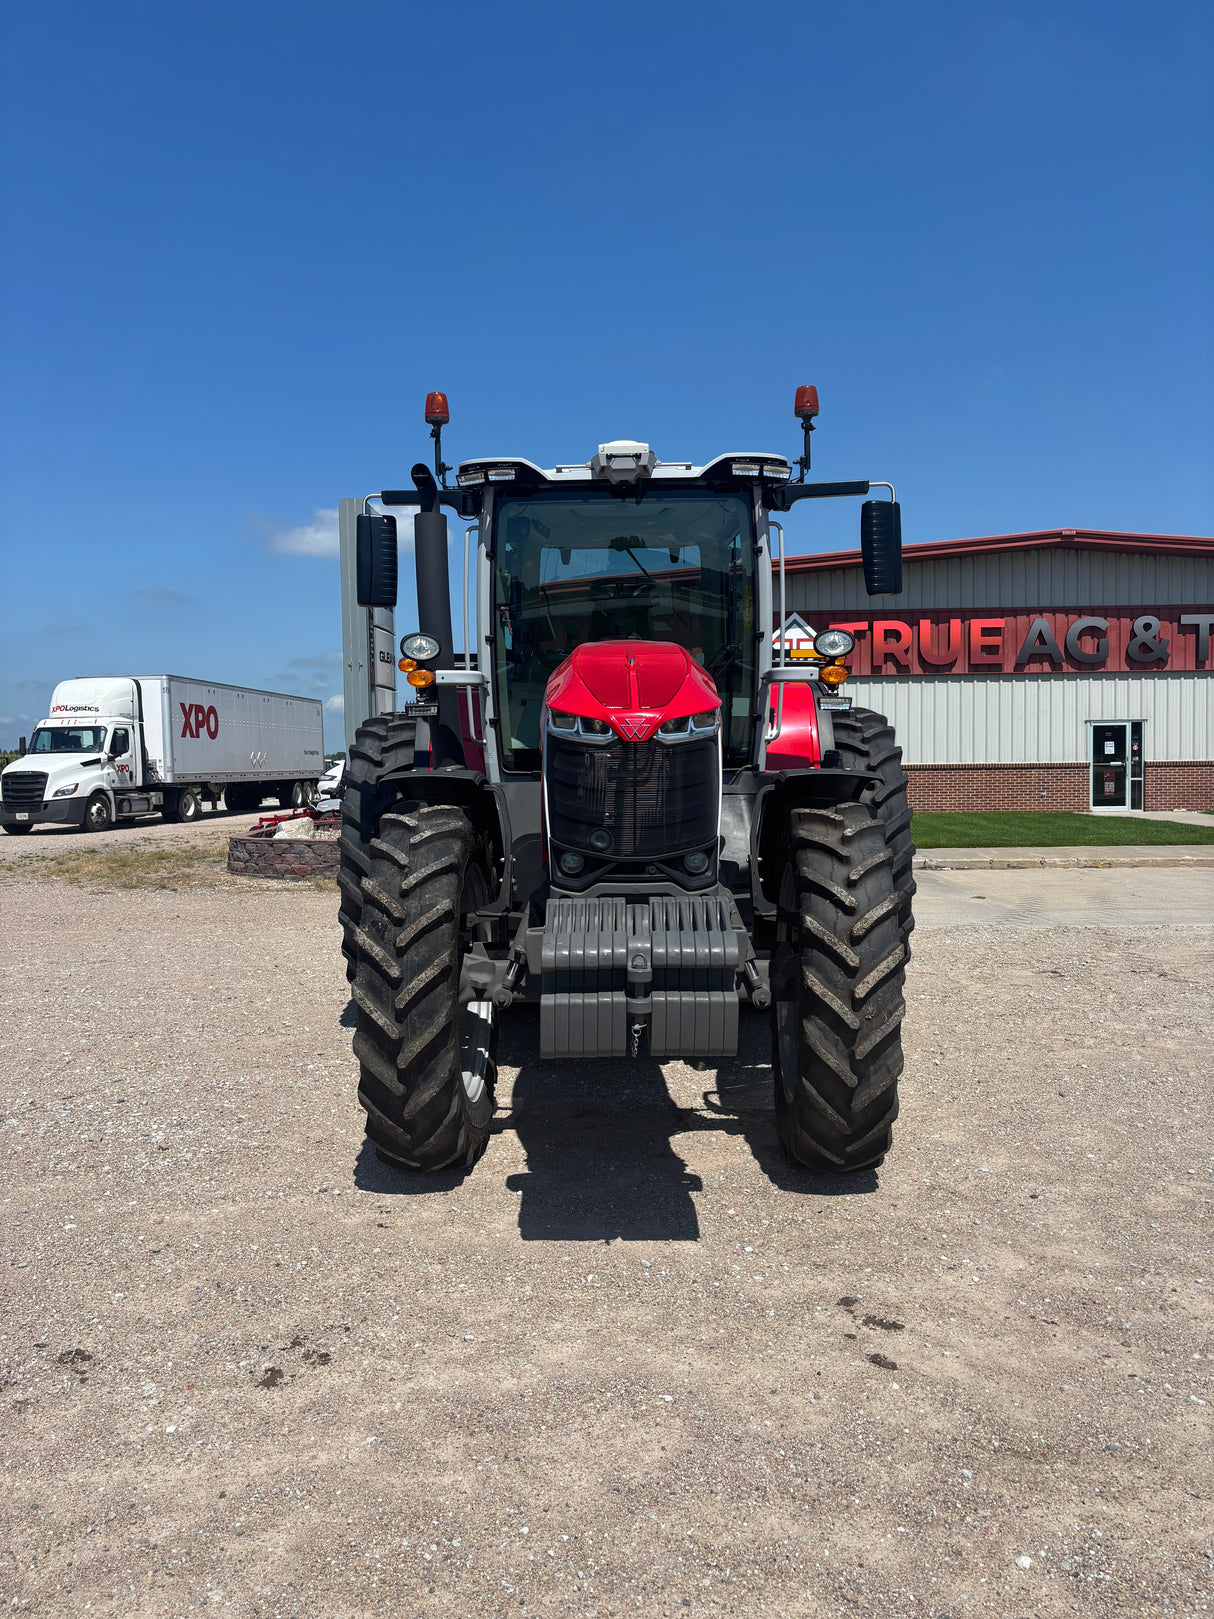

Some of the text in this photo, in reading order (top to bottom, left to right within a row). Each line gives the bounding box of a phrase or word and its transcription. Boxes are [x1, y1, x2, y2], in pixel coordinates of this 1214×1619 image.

[1016, 616, 1110, 664] AG
[1127, 615, 1171, 663] &
[179, 702, 219, 740] XPO
[116, 764, 130, 773] XPO
